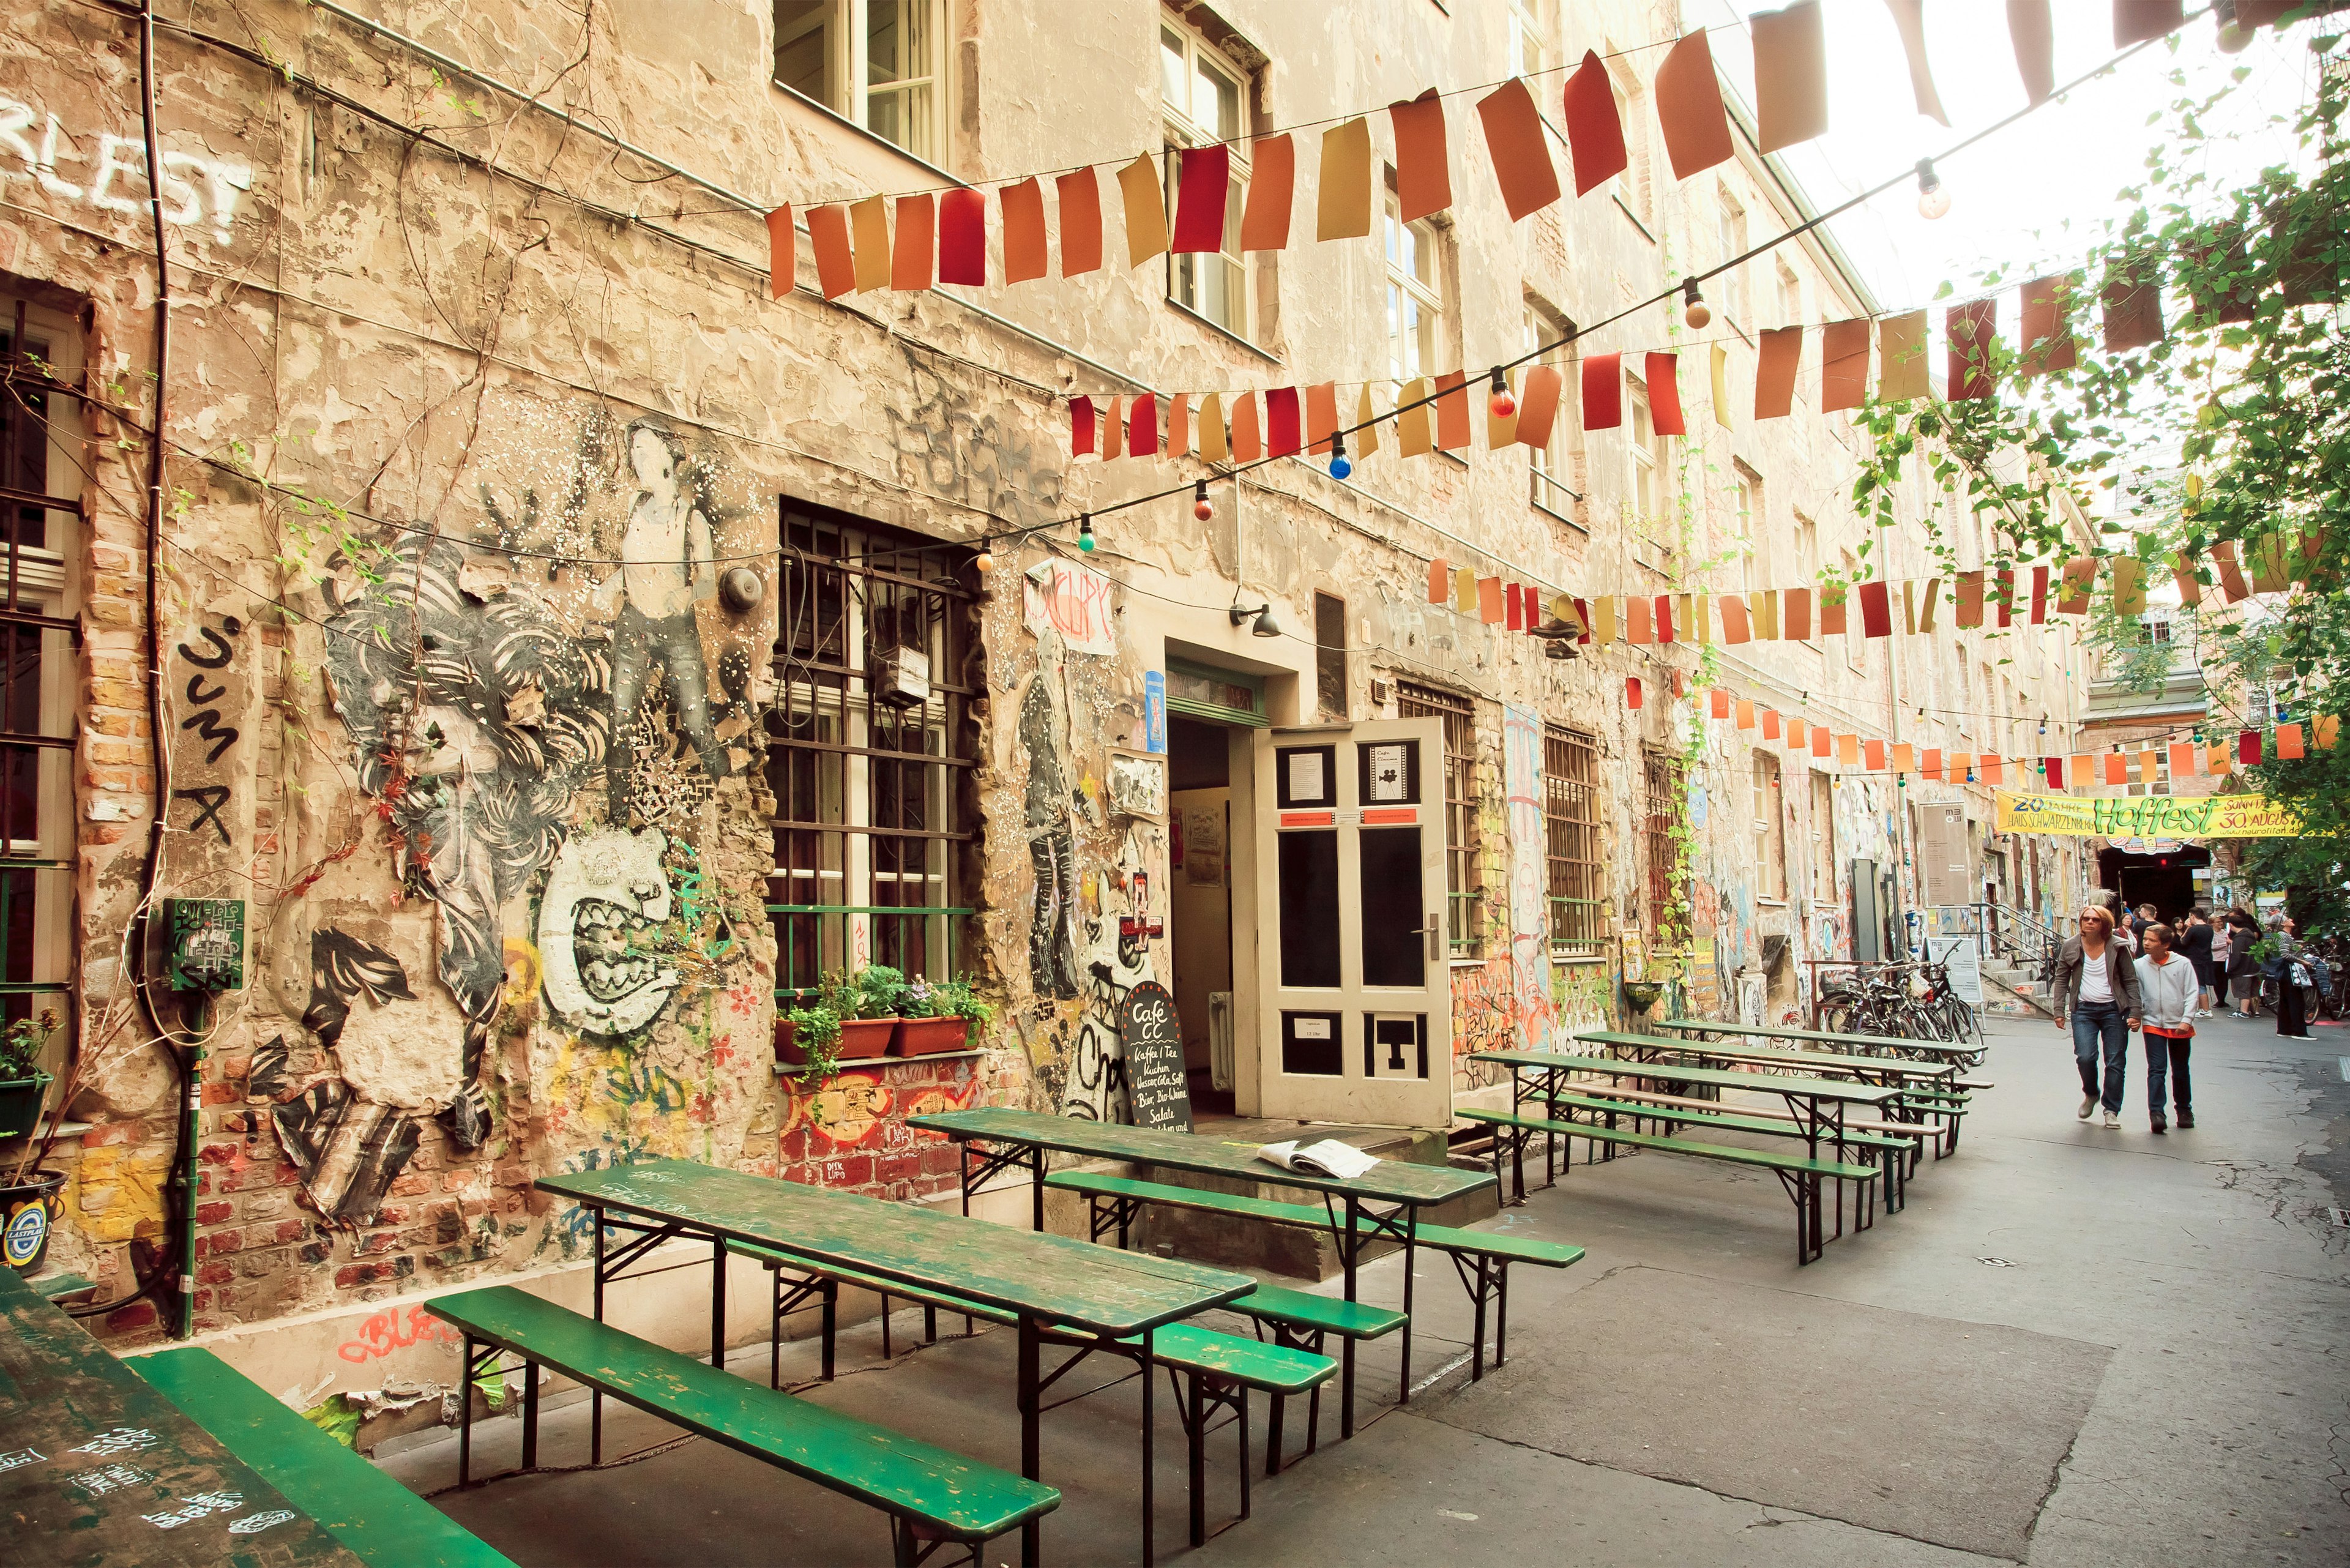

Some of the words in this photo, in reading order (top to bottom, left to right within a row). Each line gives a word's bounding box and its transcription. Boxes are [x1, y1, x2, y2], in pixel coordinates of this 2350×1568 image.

[2013, 796, 2044, 813] 20
[2044, 799, 2086, 813] JAHRE
[2008, 813, 2027, 827] HAUS
[2029, 813, 2095, 831] SCHWARZENBERG
[2094, 797, 2221, 835] Hoffest
[2219, 812, 2247, 829] 30.
[1132, 1000, 1168, 1026] Café
[1142, 1022, 1163, 1039] CC
[1135, 1046, 1158, 1064] Kaffee
[1165, 1045, 1178, 1058] Tee
[1144, 1061, 1170, 1076] Kuchen
[1137, 1092, 1155, 1108] Bier,
[1157, 1087, 1187, 1103] Bio-Weine
[1149, 1106, 1175, 1124] Salate
